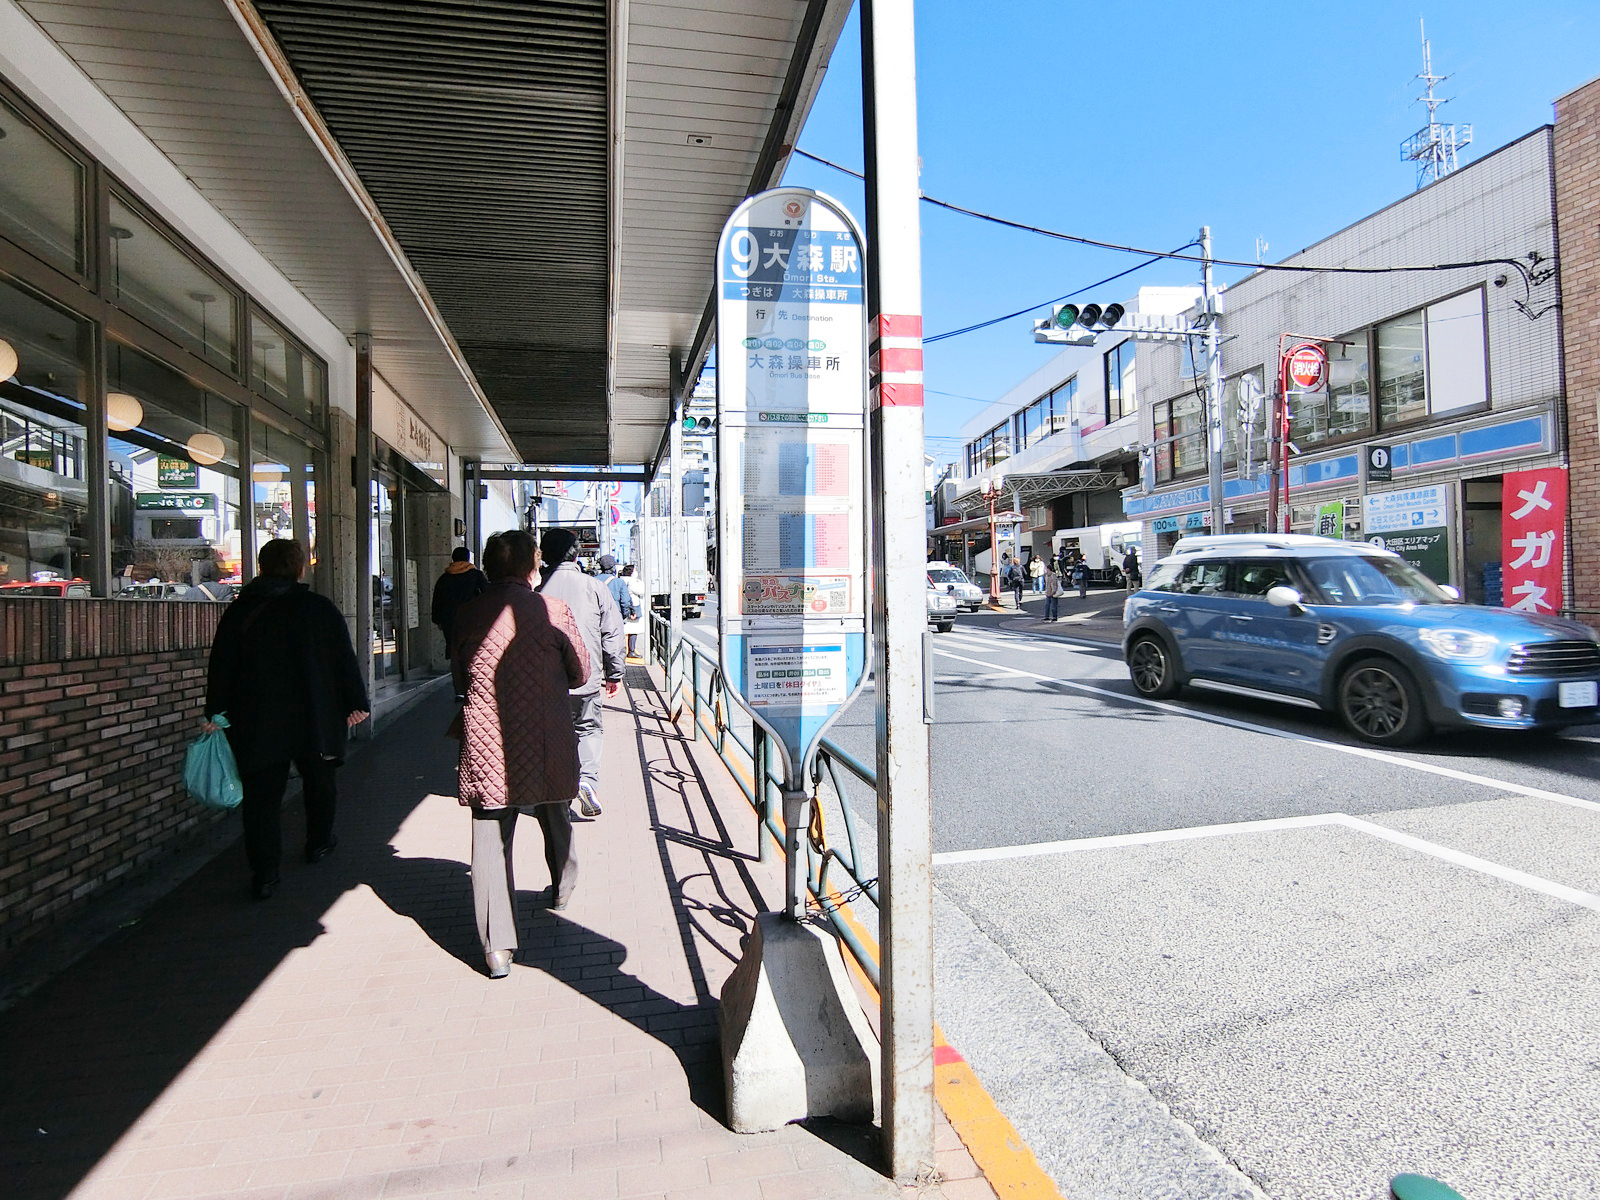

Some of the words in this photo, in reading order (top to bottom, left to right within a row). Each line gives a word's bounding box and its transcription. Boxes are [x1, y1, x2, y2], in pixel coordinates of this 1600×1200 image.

[731, 230, 760, 278] 9
[763, 242, 857, 274] 大森駅
[816, 274, 838, 283] Sta.
[740, 286, 773, 298] つぎは
[792, 288, 848, 301] 大森操車所
[791, 314, 833, 322] Destination
[749, 353, 840, 371] 大森操車所
[1294, 361, 1320, 376] 消火栓
[1152, 487, 1203, 510] LAWSON
[1385, 534, 1440, 546] 大田区エリアマップ
[1509, 481, 1556, 614] メガネ
